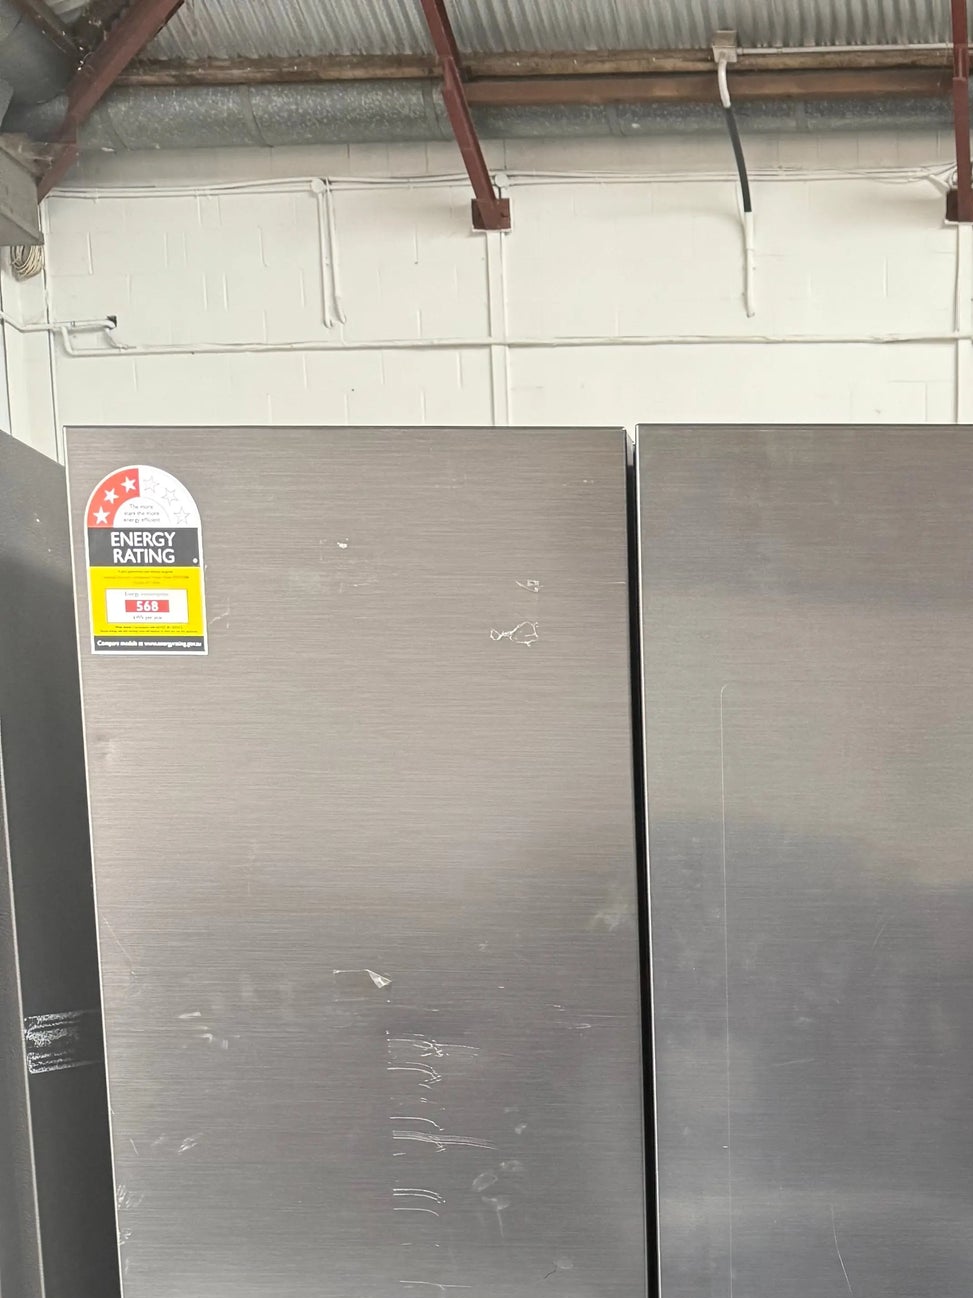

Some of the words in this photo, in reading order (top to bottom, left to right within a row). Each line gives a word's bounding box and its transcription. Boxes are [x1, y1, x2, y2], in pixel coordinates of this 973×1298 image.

[110, 531, 176, 547] ENERGY
[113, 548, 175, 564] RATING
[136, 600, 159, 612] 568
